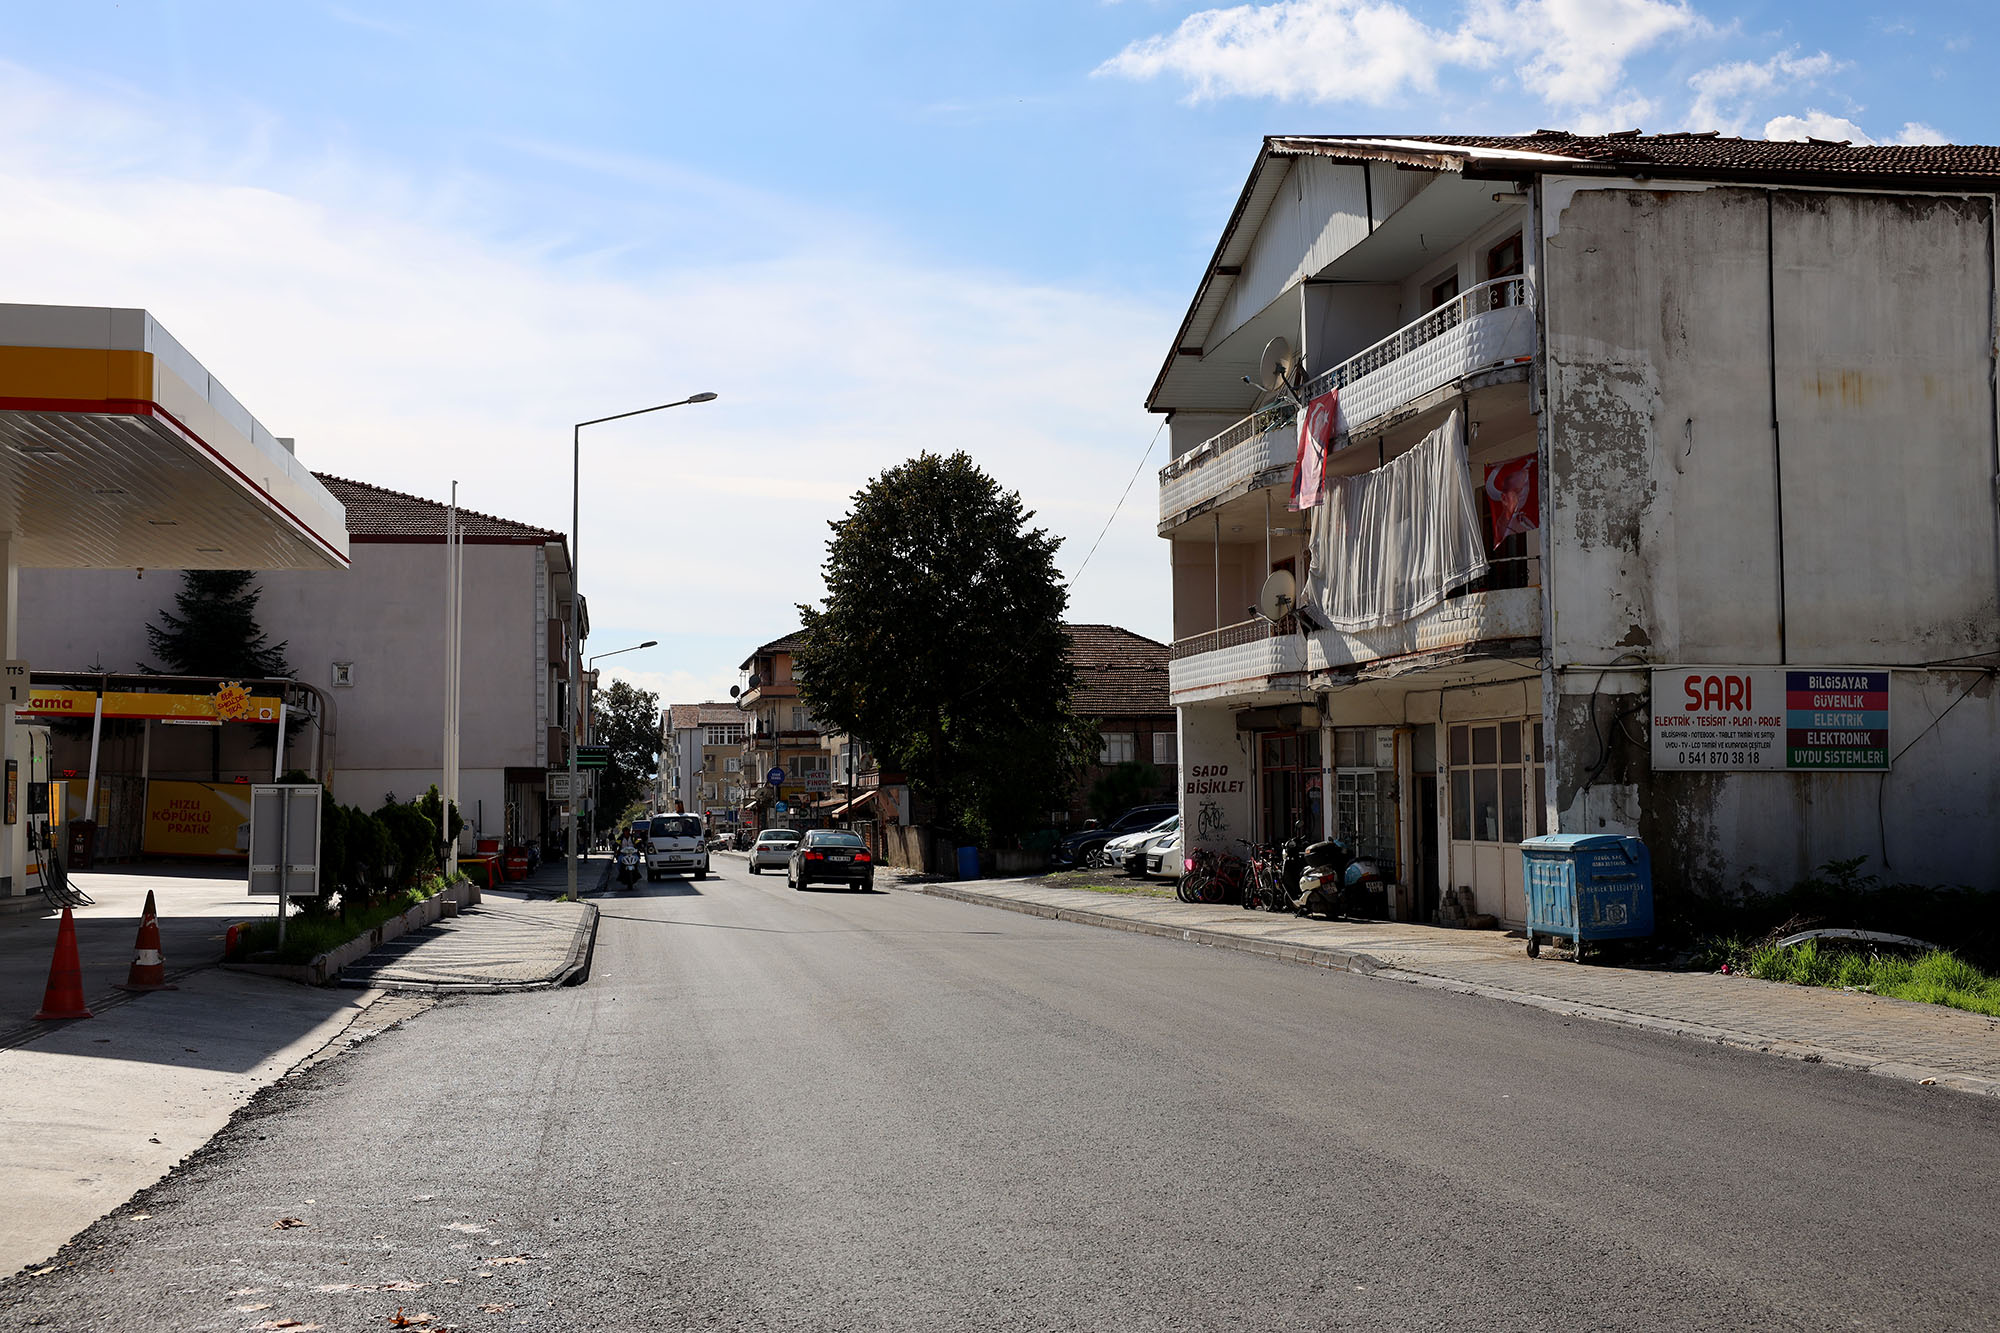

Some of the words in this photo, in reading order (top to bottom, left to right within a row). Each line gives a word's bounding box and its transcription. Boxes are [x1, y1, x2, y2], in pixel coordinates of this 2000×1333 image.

[5, 666, 24, 675] TTS
[1808, 676, 1869, 689] BİLGİSAYAR
[10, 686, 17, 700] 1
[1684, 675, 1752, 711] SARI
[1813, 694, 1864, 708] GÜVENLİK
[1654, 715, 1691, 727] ELEKTRİK
[1696, 715, 1727, 727] TESİSAT
[1732, 717, 1753, 727] PLAN
[1758, 717, 1781, 727] PROJE
[1813, 713, 1864, 727] ELEKTRİK
[1718, 731, 1736, 739] TABLET
[1753, 731, 1760, 739] VE
[1807, 731, 1871, 745] ELEKTRONİK
[1679, 752, 1685, 764] 0
[1688, 752, 1706, 764] 541
[1710, 752, 1729, 764] 870
[1731, 752, 1744, 764] 38
[1748, 752, 1760, 764] 18
[1794, 750, 1822, 763] UYDU
[1824, 750, 1884, 764] SİSTEMLERİ
[1192, 765, 1228, 777] SADO
[169, 799, 200, 810] HIZLI
[152, 808, 211, 823] KÖPÜKLÜ
